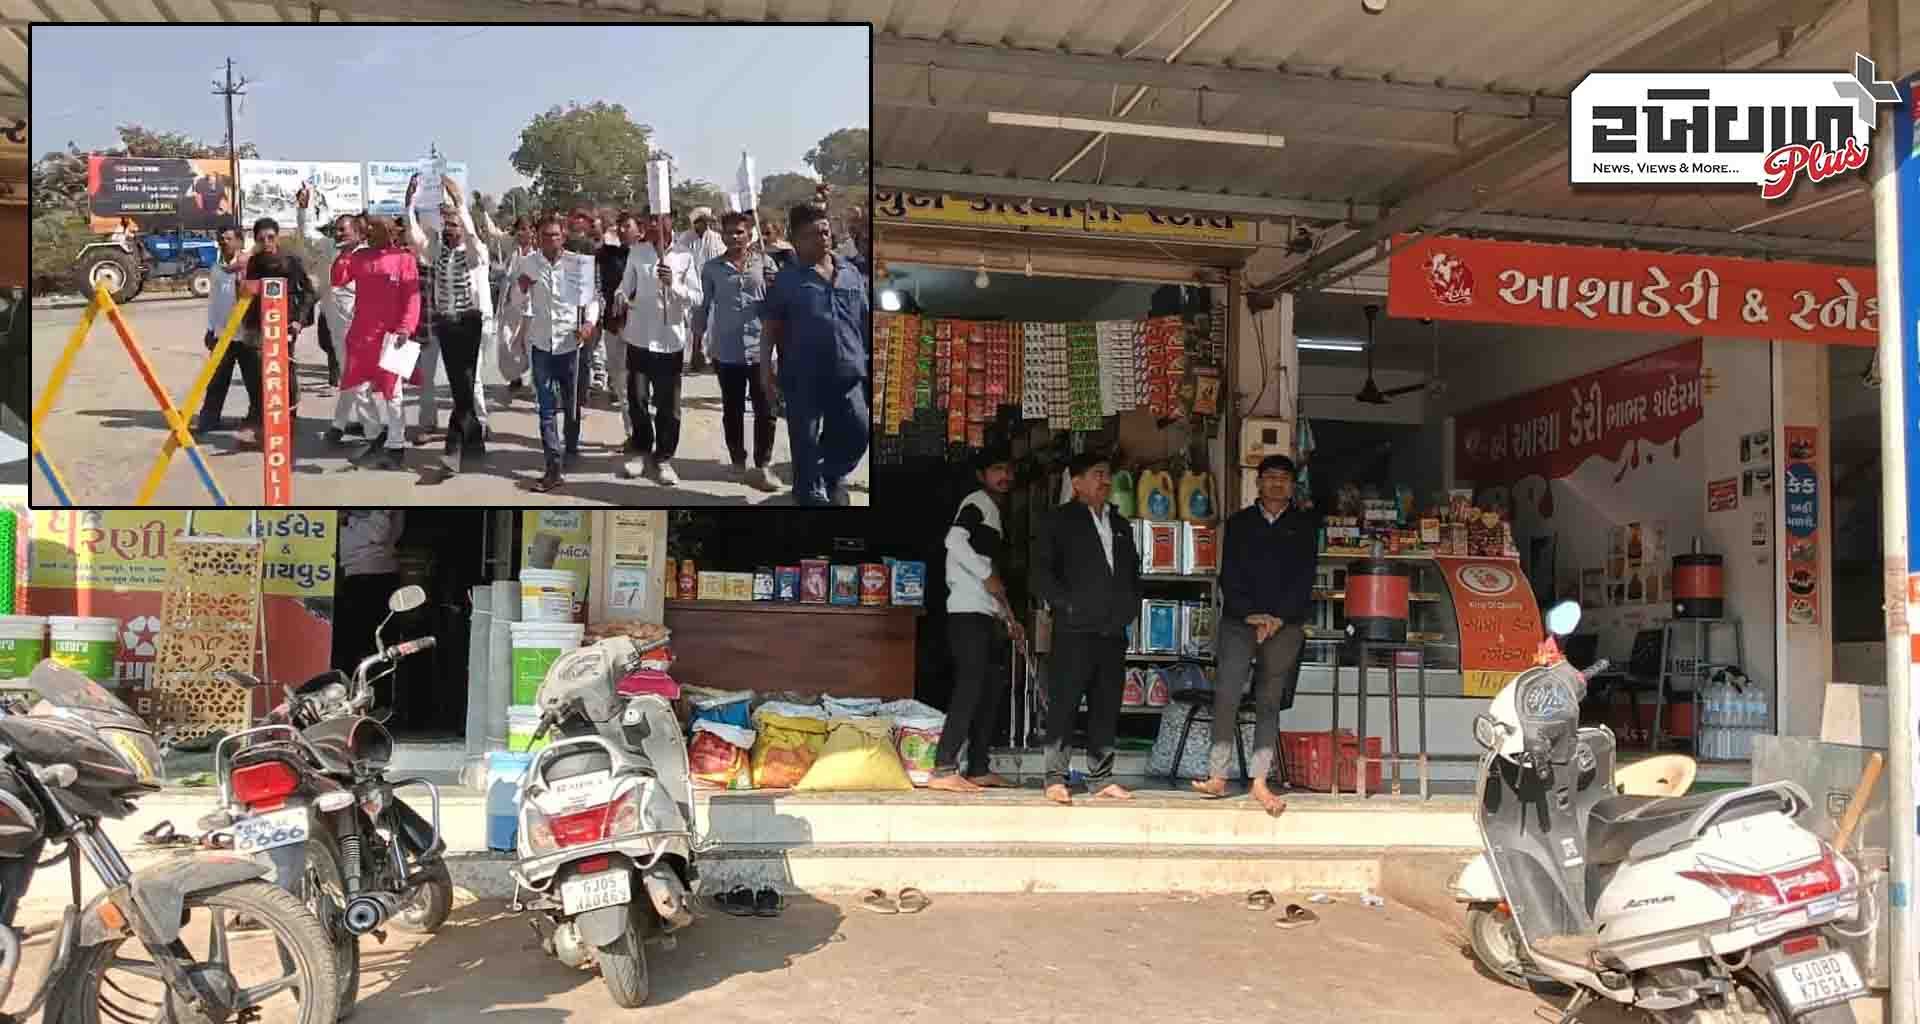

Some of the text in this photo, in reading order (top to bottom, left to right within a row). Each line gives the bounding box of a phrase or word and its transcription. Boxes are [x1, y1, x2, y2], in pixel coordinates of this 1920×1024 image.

[1499, 266, 1720, 326] આશાડેરી
[1742, 288, 1769, 323] &
[264, 308, 286, 507] GUJARAT POLI
[280, 543, 291, 555] &
